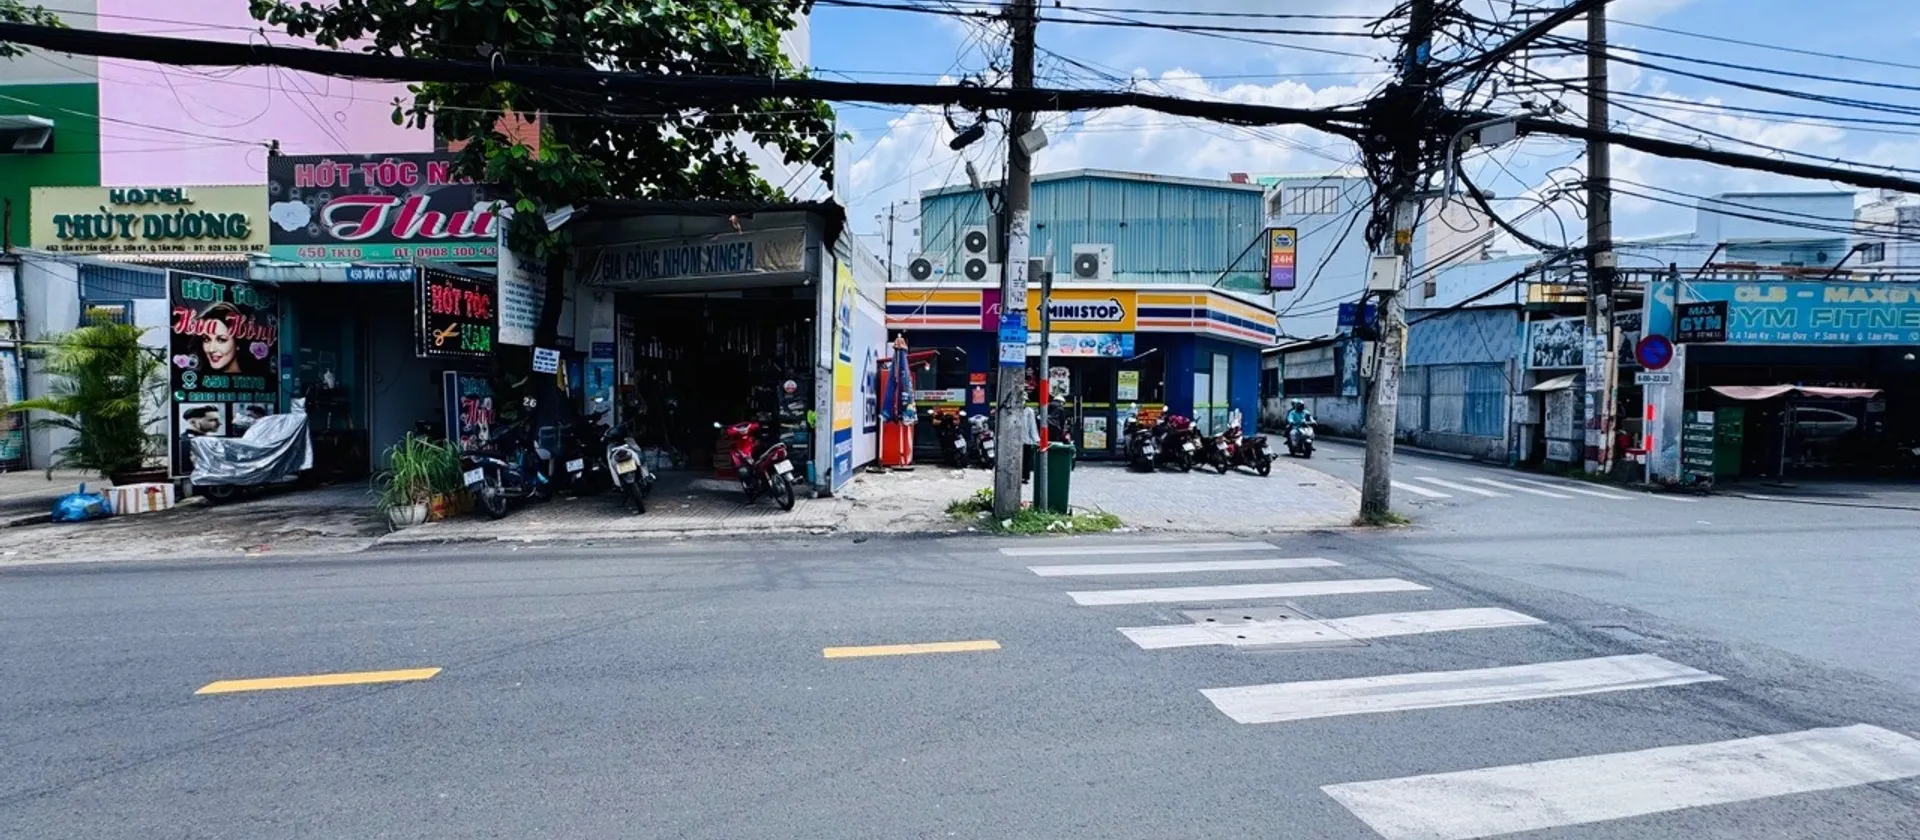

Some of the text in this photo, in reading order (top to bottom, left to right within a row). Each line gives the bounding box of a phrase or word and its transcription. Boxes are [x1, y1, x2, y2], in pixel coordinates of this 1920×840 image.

[109, 188, 194, 206] HOTEL
[142, 207, 252, 241] DƯƠNG
[297, 247, 326, 258] 450
[706, 241, 755, 273] XINGFA
[1273, 254, 1293, 264] 24H
[1047, 305, 1119, 319] MINISTOP
[1688, 306, 1715, 316] MAX
[1680, 315, 1722, 332] GYM
[523, 396, 537, 408] 26
